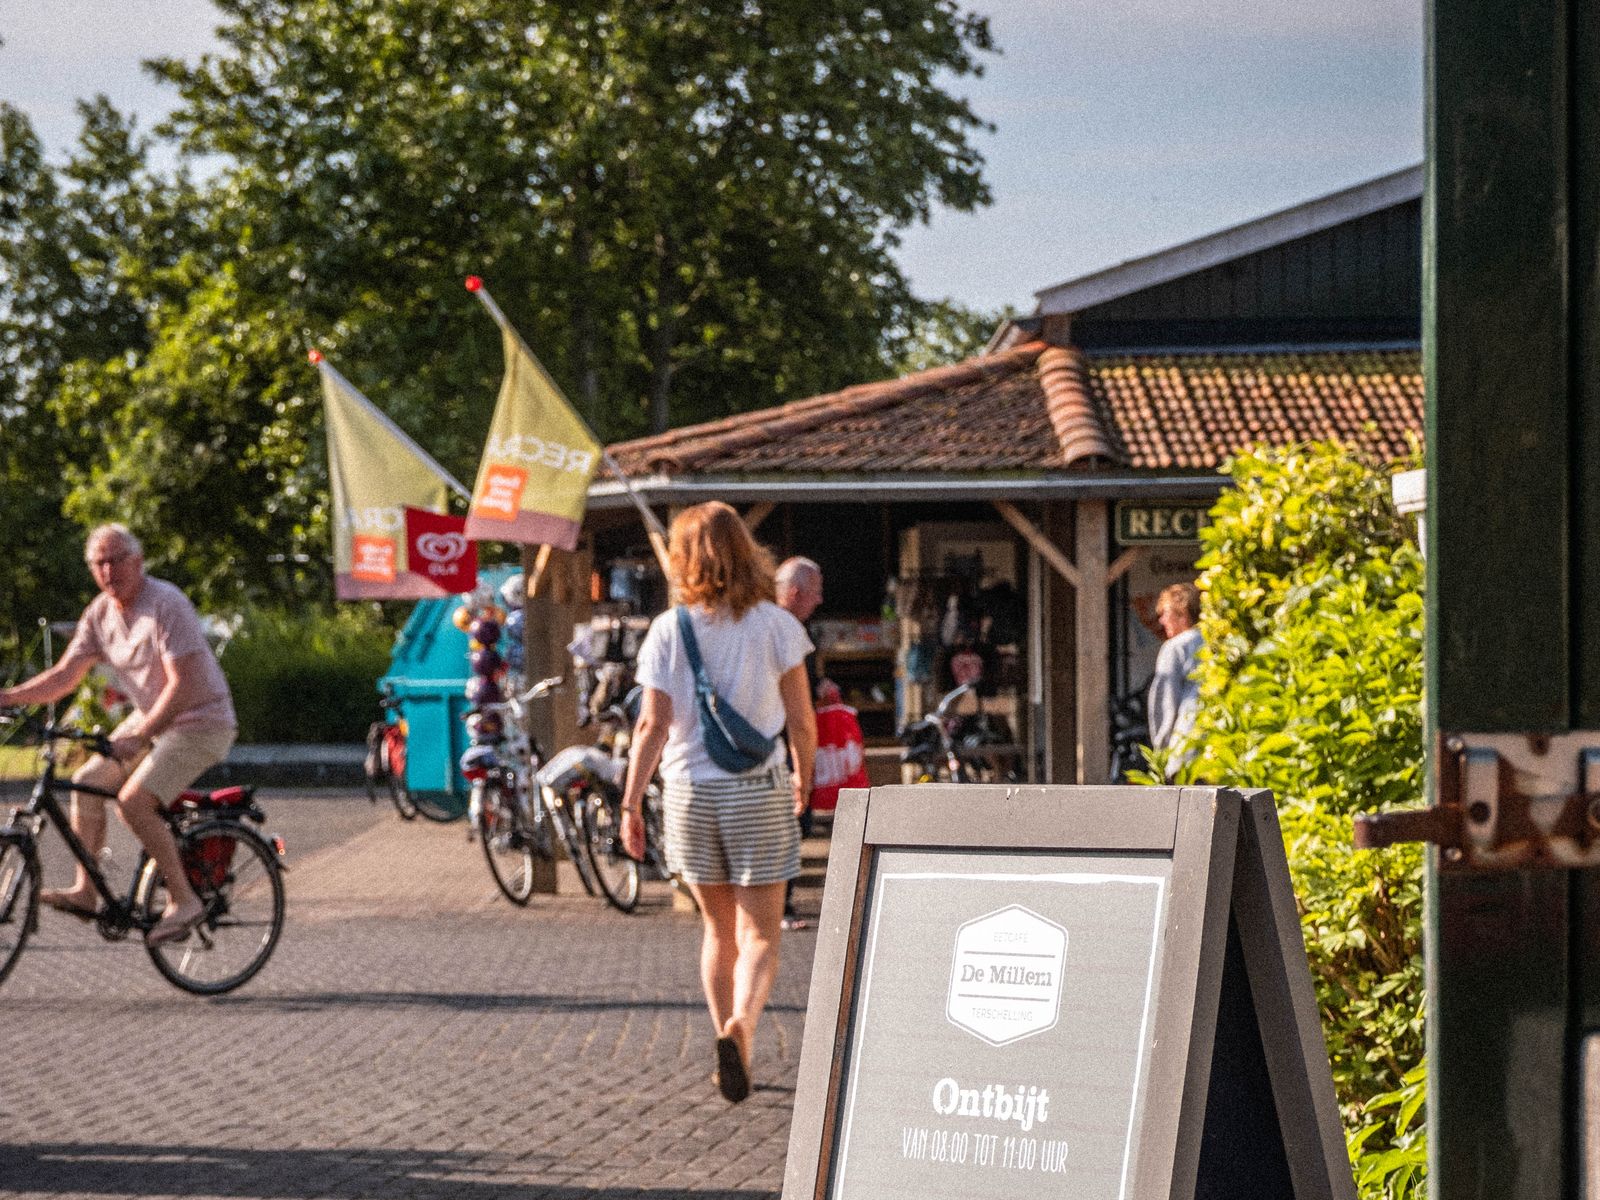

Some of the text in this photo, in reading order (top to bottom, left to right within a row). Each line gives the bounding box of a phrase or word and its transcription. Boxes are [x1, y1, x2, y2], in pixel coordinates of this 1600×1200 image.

[961, 964, 984, 982] De
[972, 1007, 1033, 1022] TERSCHELLING
[932, 1077, 1050, 1131] Ontbijt
[903, 1127, 1068, 1173] VAN 08:00 TOT 11:00 UUR
